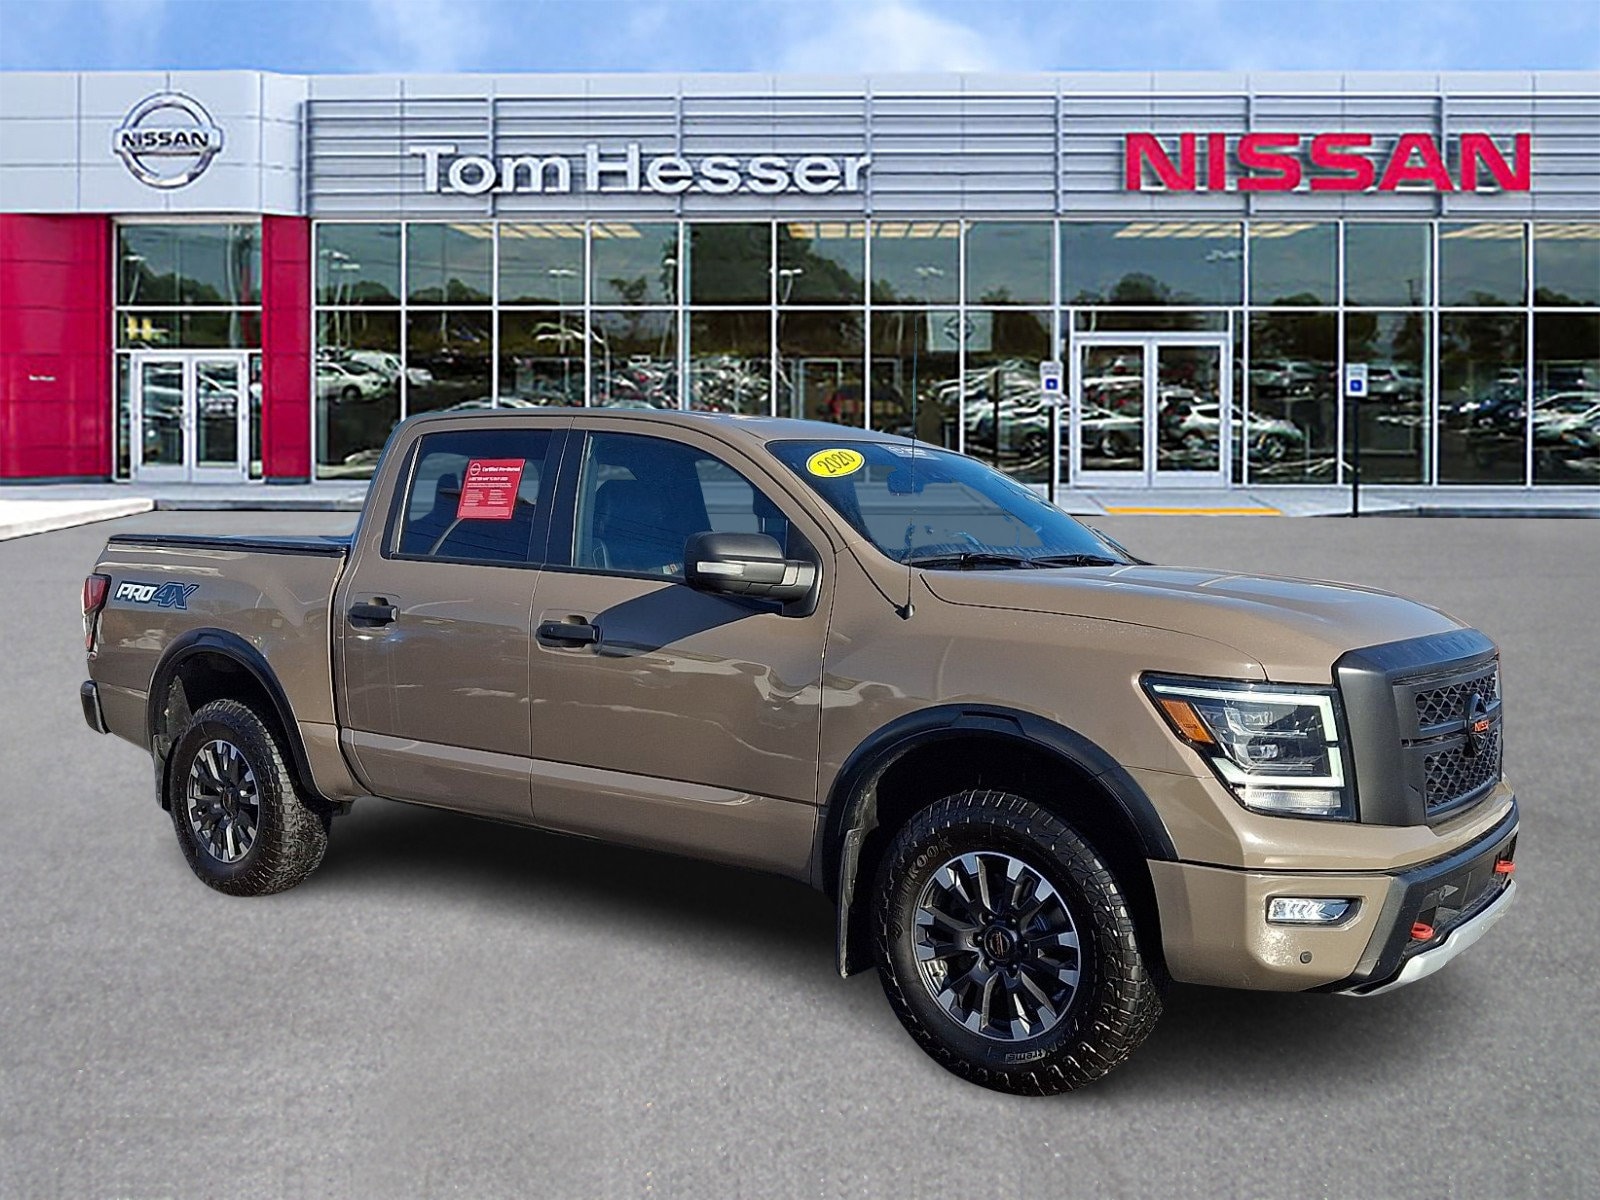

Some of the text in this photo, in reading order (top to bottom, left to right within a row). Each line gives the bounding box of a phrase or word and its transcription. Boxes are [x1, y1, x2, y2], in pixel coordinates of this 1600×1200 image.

[121, 132, 209, 147] NISSAN
[408, 143, 869, 194] Tom Hesser
[1125, 132, 1531, 192] NISSAN
[817, 451, 856, 474] 2020
